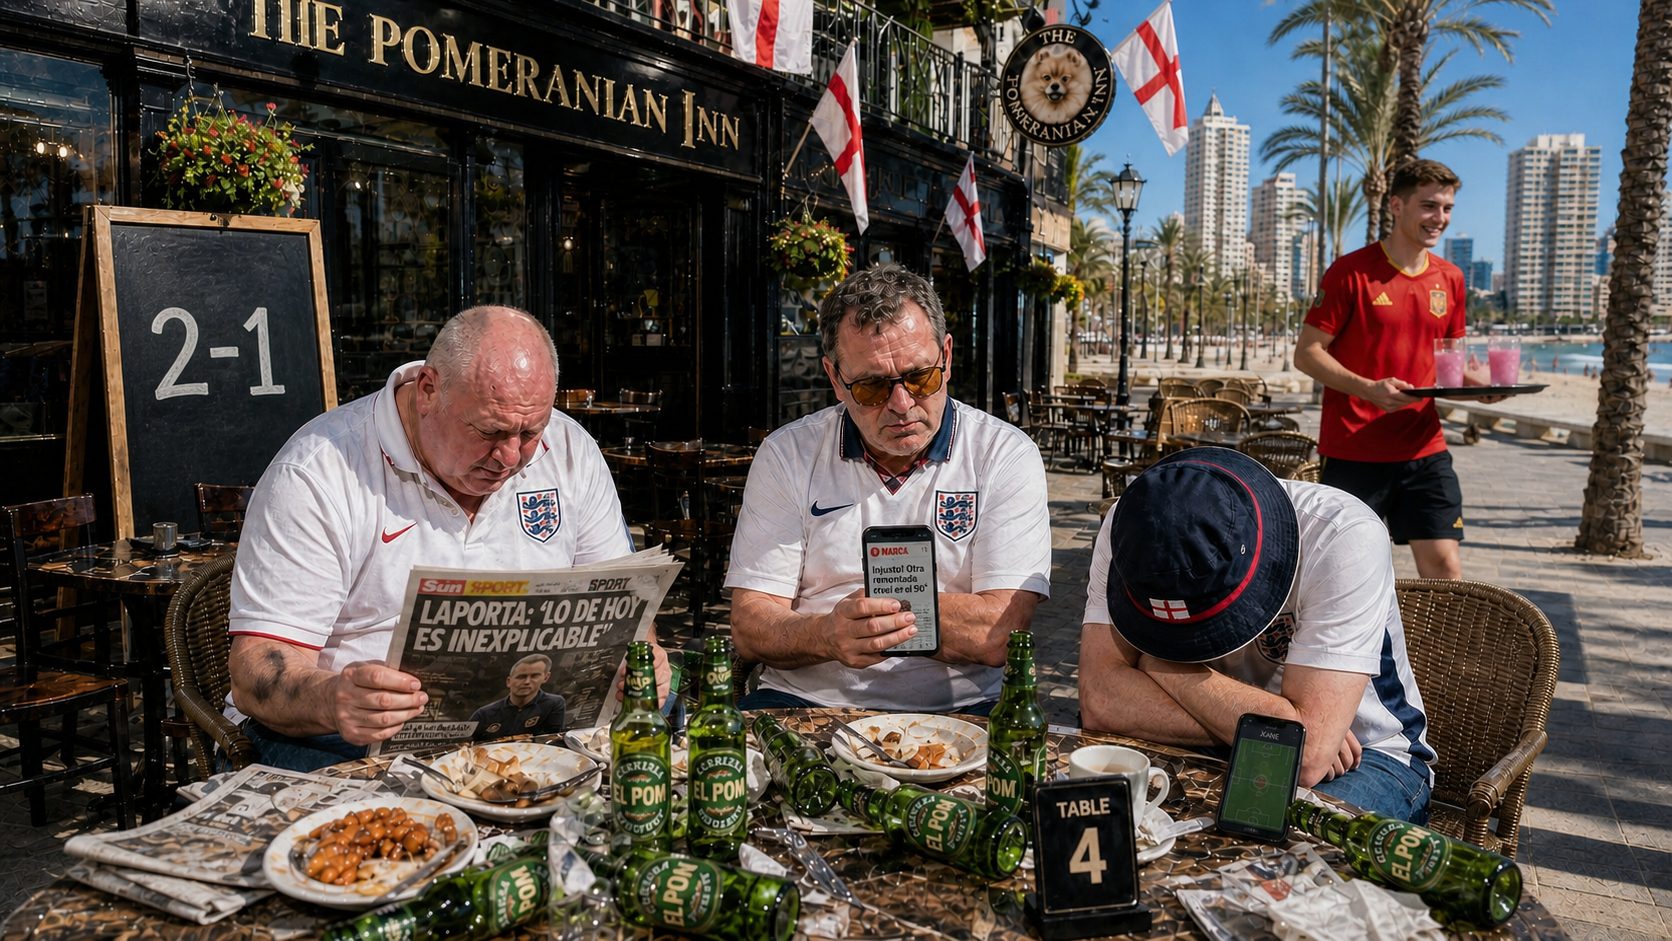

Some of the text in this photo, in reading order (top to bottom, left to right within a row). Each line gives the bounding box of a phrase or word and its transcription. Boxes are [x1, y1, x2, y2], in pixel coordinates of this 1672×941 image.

[1039, 29, 1076, 45] THE
[367, 13, 669, 134] POMERANIAN
[151, 307, 285, 400] 2-1
[906, 564, 925, 573] Otra
[422, 580, 464, 593] Sun
[419, 600, 535, 626] LAPORTA:
[572, 598, 602, 623] DE
[601, 595, 641, 621] HOY
[413, 627, 447, 651] ES
[613, 783, 666, 806] EL POM
[694, 777, 745, 802] EL POM
[986, 773, 1017, 798] POM
[1056, 797, 1111, 818] TABLE
[926, 832, 944, 852] EL
[1069, 826, 1107, 884] 4
[1391, 861, 1413, 882] EL
[663, 906, 686, 927] EL
